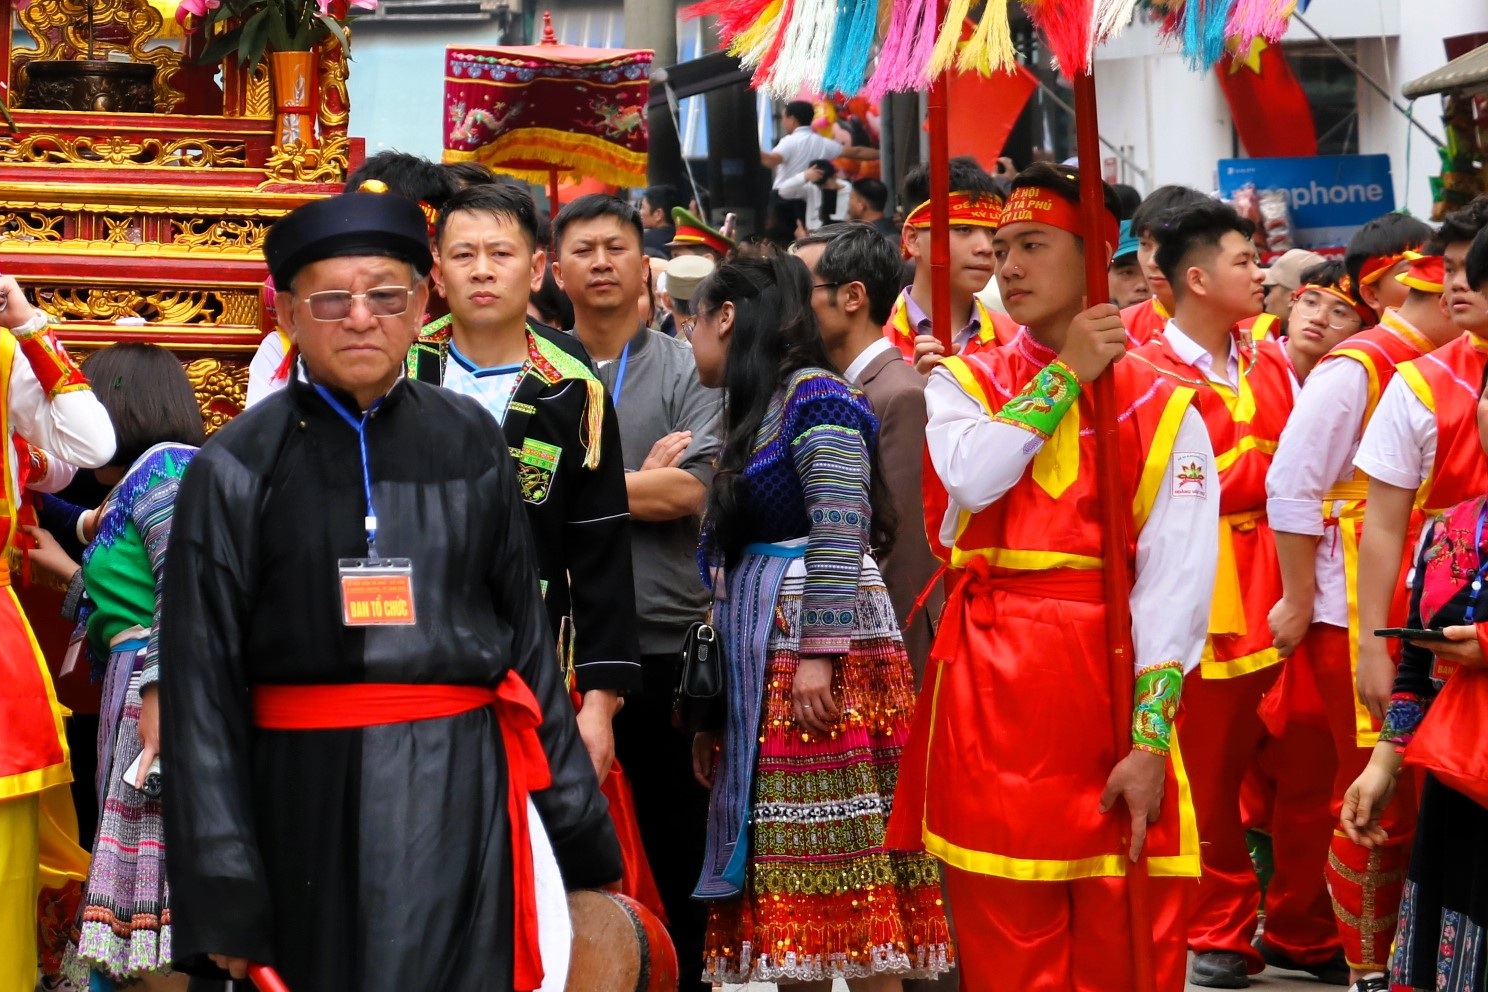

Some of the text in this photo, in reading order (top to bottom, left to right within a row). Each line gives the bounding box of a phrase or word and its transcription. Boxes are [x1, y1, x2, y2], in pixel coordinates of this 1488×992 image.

[1020, 186, 1040, 199] HỘI
[1027, 199, 1053, 211] PHỦ
[350, 594, 408, 618] BAN TỔ CHỨC
[1438, 665, 1454, 674] BAN
